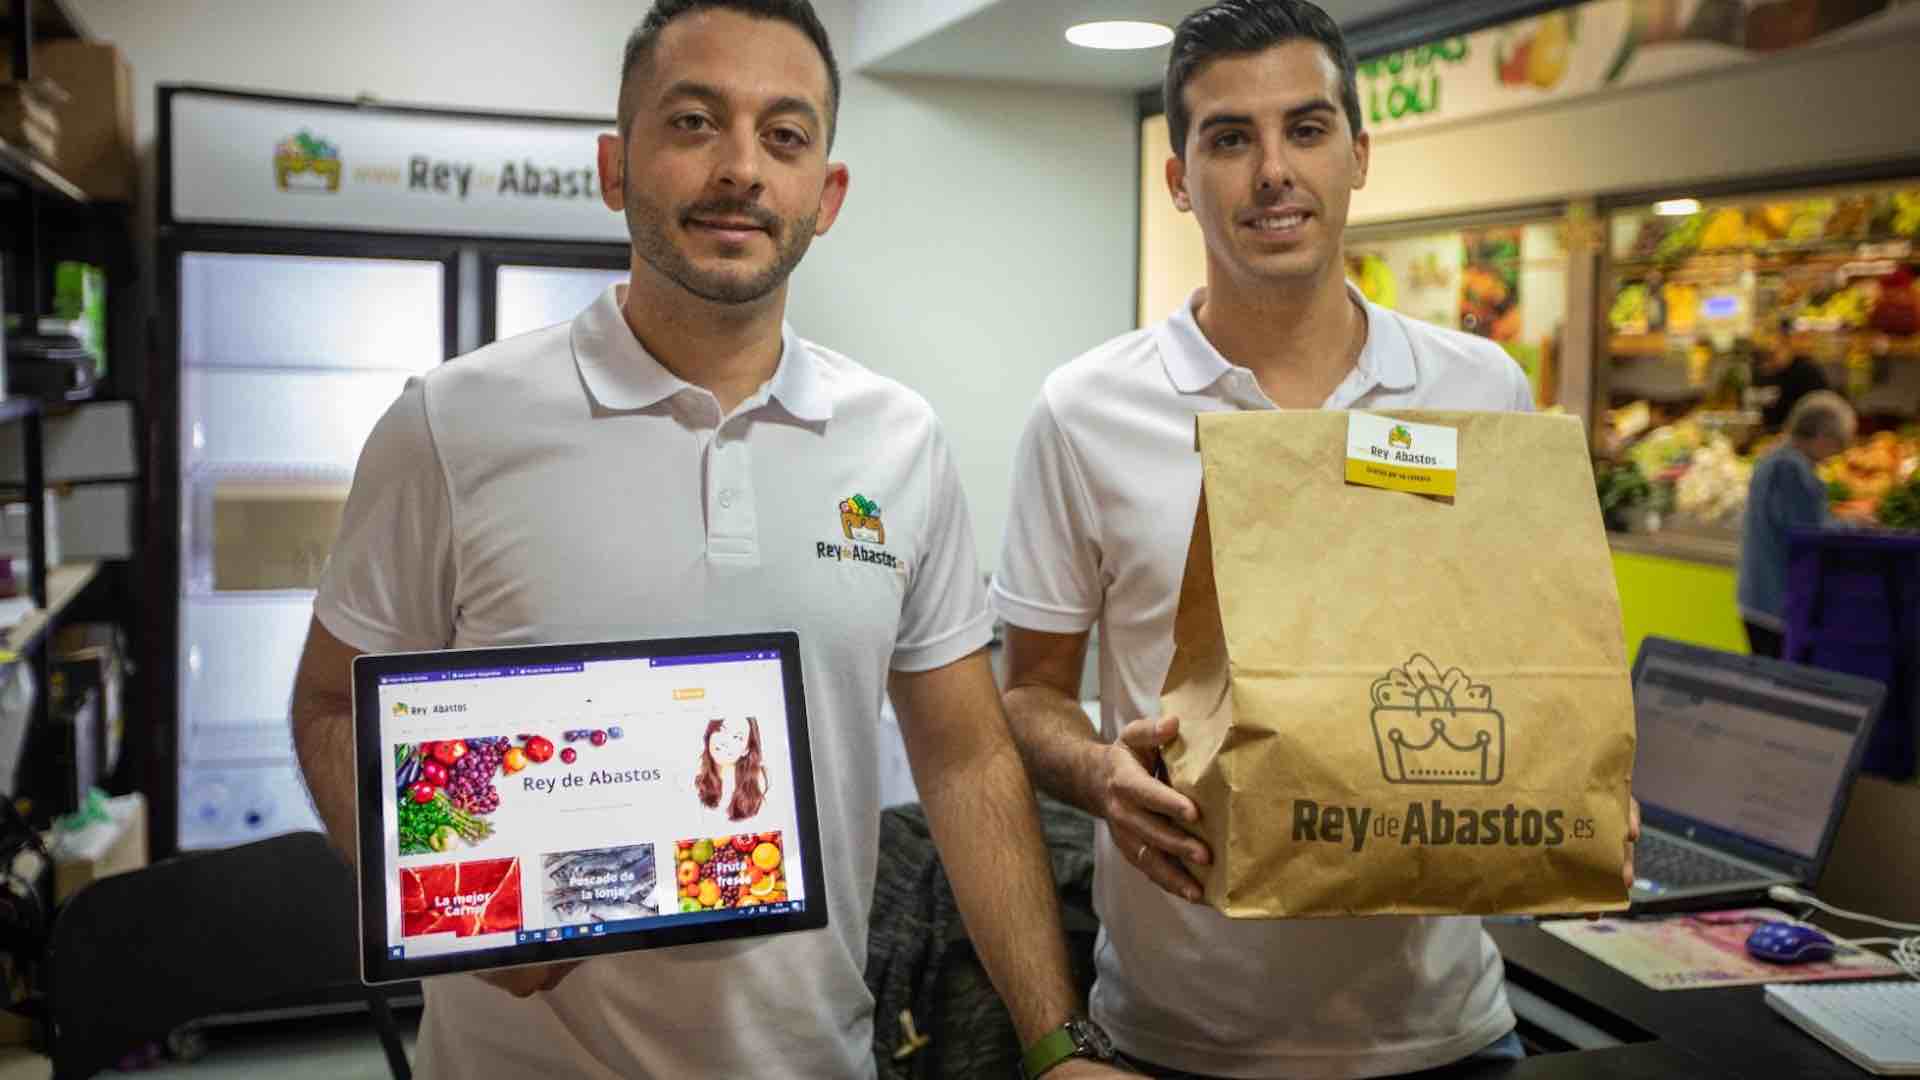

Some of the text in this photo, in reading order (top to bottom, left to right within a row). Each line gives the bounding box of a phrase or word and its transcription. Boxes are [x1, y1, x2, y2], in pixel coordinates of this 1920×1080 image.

[408, 156, 472, 200] Rey
[498, 160, 600, 199] Abast
[1371, 446, 1389, 460] Rey
[1395, 451, 1437, 465] Abastos
[816, 541, 841, 561] Rey
[852, 544, 897, 569] Abastos
[433, 703, 467, 714] Abastos
[523, 768, 661, 793] Rey de Abastos
[1292, 800, 1371, 852] Rey
[1373, 812, 1400, 838] de
[434, 892, 491, 907] La mejor
